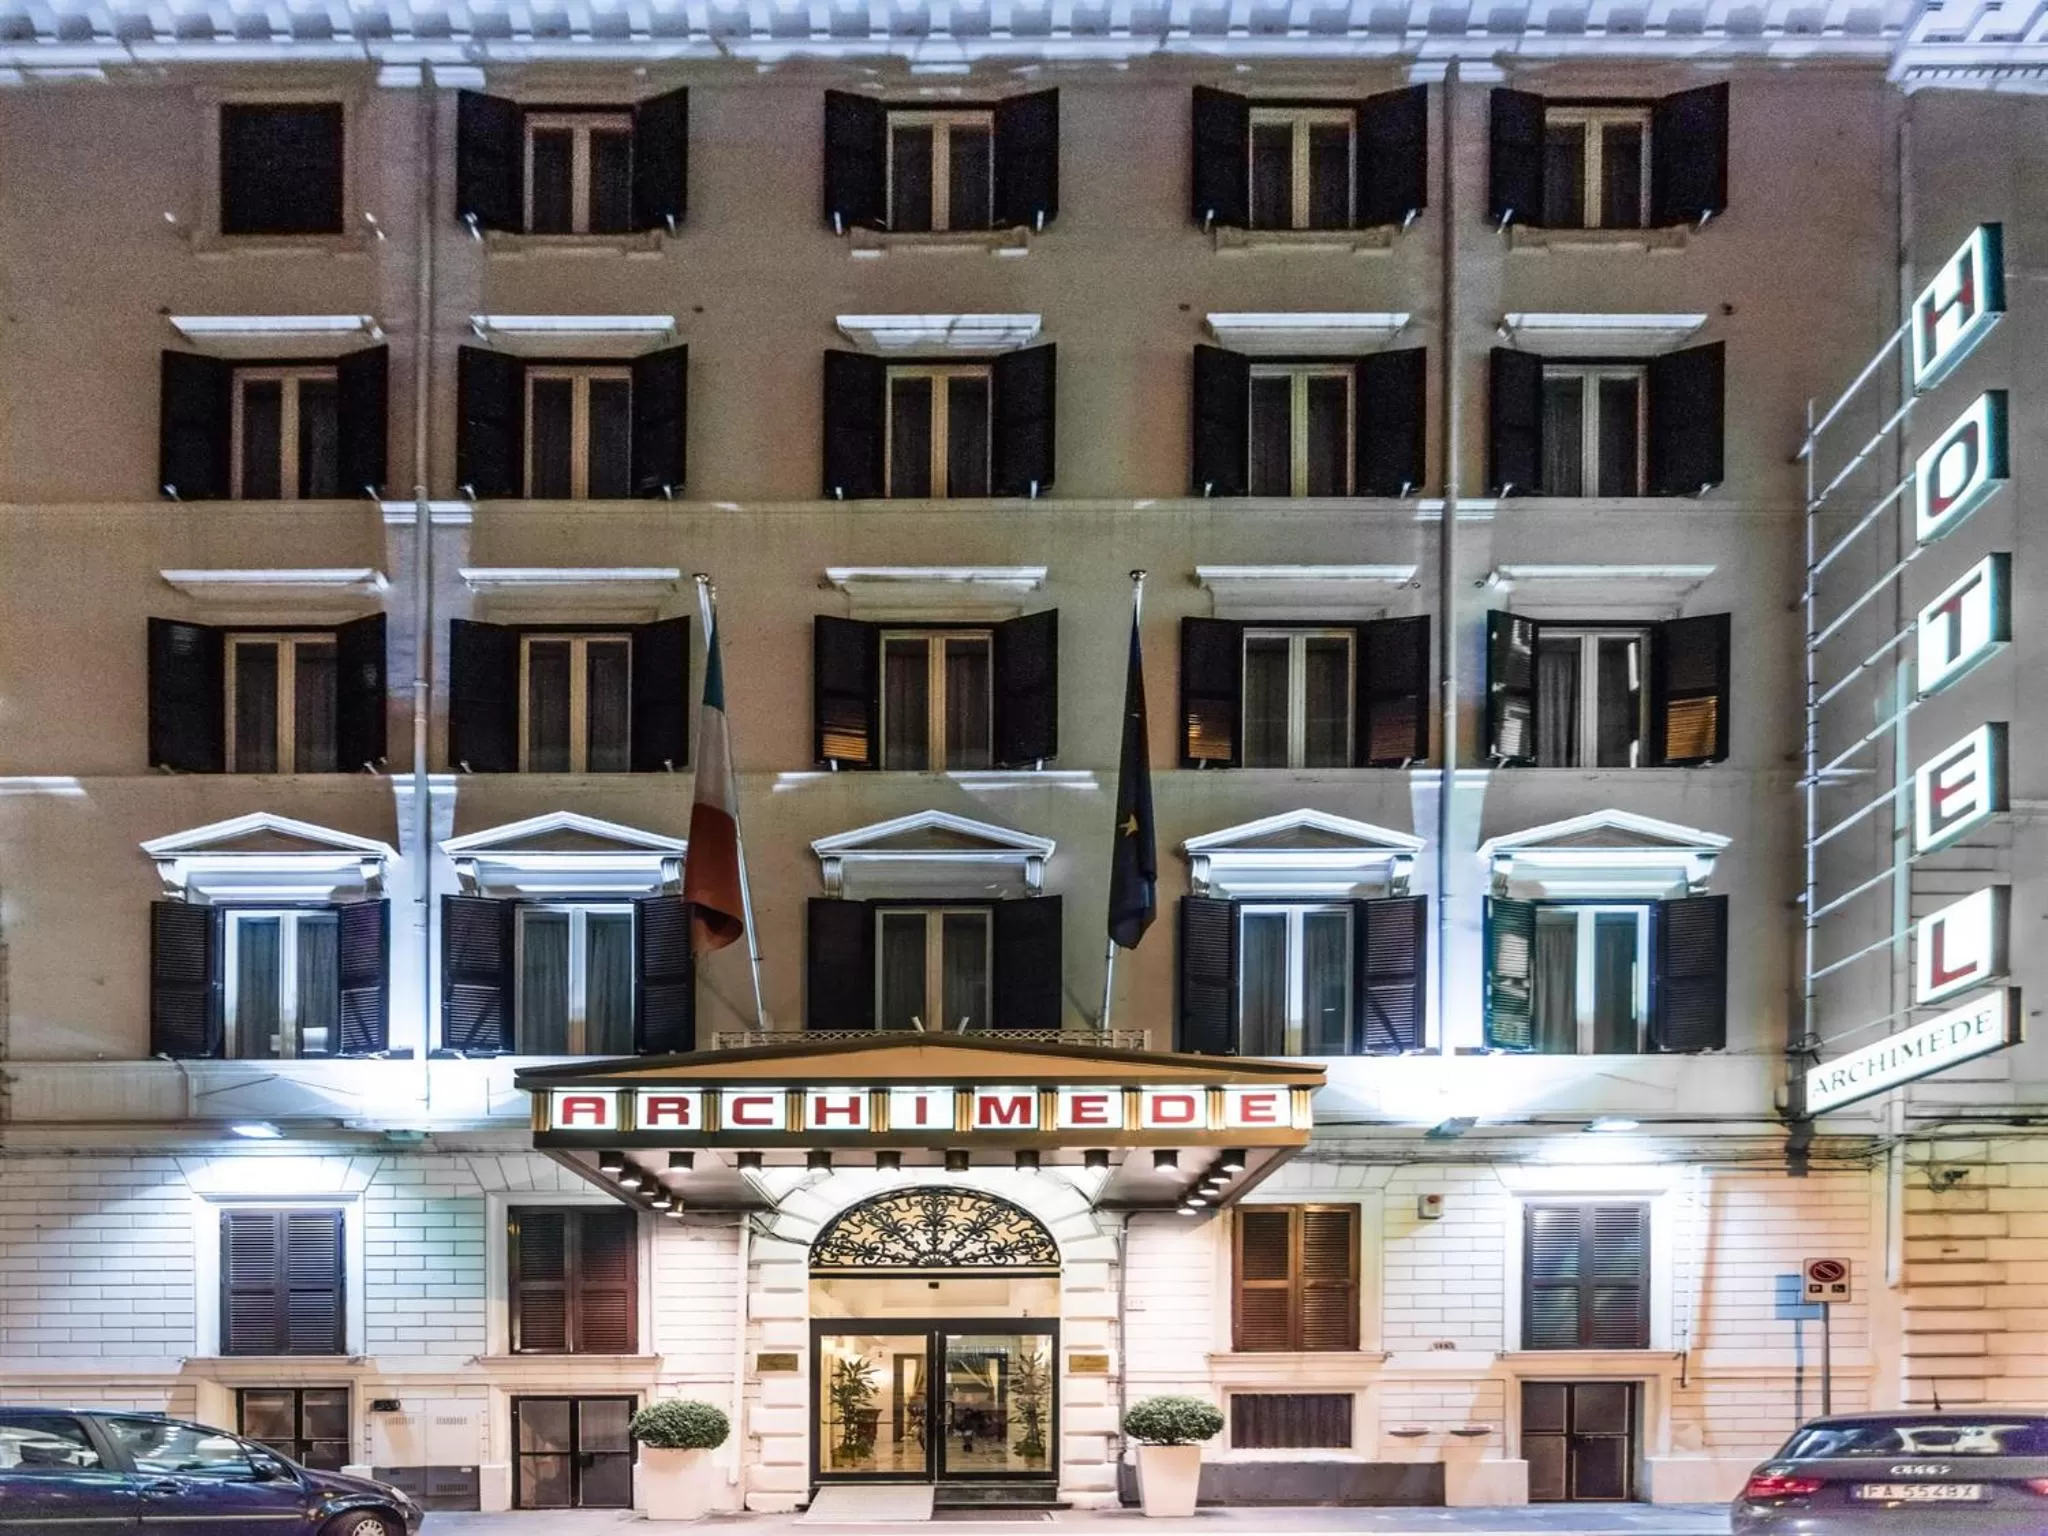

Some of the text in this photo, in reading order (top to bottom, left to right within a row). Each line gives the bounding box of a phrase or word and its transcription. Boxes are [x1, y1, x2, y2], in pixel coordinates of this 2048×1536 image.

[1920, 245, 1982, 988] HOTEL
[1812, 1009, 1994, 1098] ARCHIMEDE
[562, 1094, 1277, 1125] ARCHIMEDE
